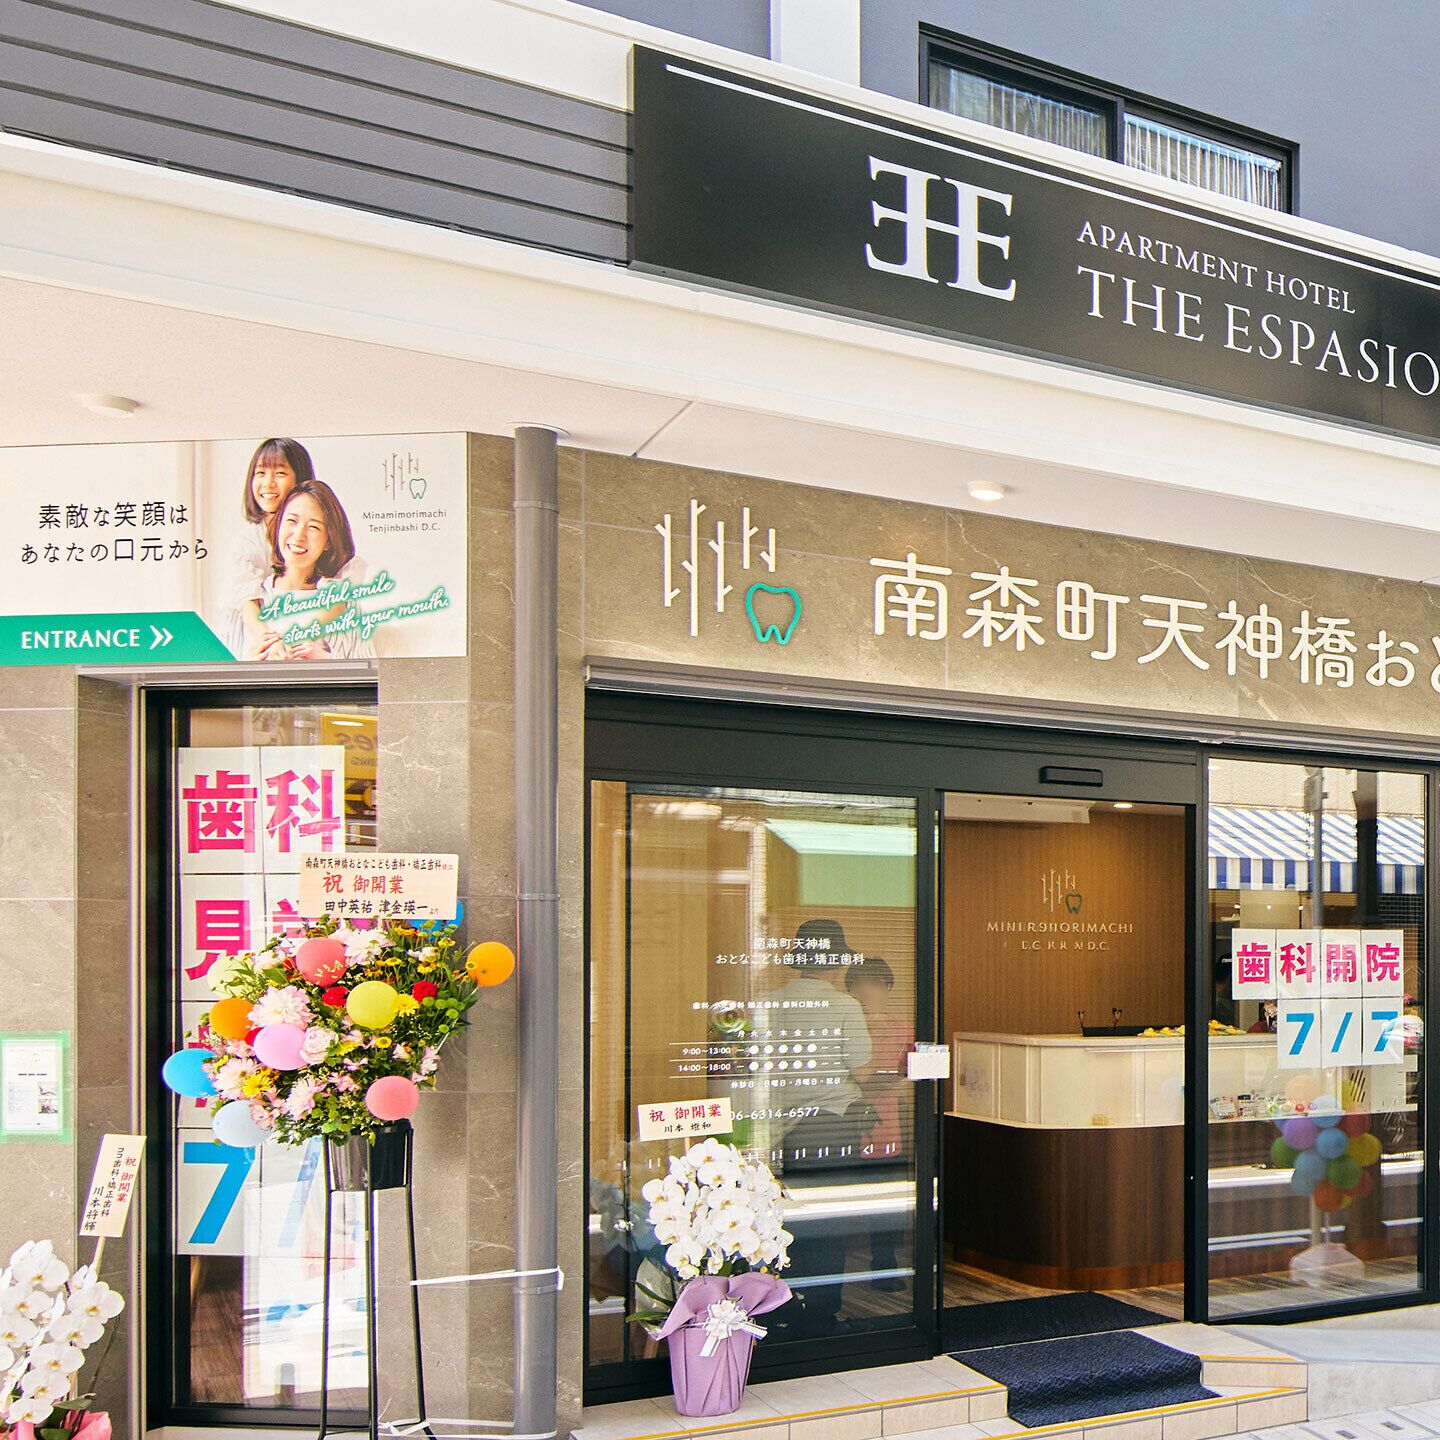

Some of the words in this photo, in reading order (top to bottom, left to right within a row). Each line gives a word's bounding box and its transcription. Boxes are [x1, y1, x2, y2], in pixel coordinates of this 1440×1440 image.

[1077, 221, 1258, 288] APARTMENT
[1265, 269, 1356, 314] HOTEL
[1077, 265, 1205, 342] THE
[38, 501, 188, 530] 素敵な笑顔は
[362, 509, 447, 520] Minamimorimachi
[369, 523, 418, 534] Tenjinbashi
[421, 522, 441, 531] D.C.
[21, 537, 209, 565] あなたの口元から
[259, 597, 281, 620] A
[283, 580, 351, 615] beautiful
[352, 572, 394, 600] smile
[284, 622, 321, 644] starts
[325, 608, 360, 633] with
[361, 609, 393, 640] your
[398, 588, 449, 617] mouth.
[21, 628, 141, 650] ENTRANCE
[183, 769, 342, 853] 歯科
[321, 871, 344, 894] 祝
[353, 874, 405, 895] 御開業
[753, 938, 831, 950] 南森町天神橋
[1235, 941, 1401, 985] 歯科開院
[1285, 1010, 1399, 1056] 7/7
[649, 1109, 666, 1123] 祝
[674, 1103, 722, 1120] 御開業
[663, 1124, 684, 1133] 川本
[124, 1156, 137, 1167] 祝
[115, 1171, 134, 1203] 御開業
